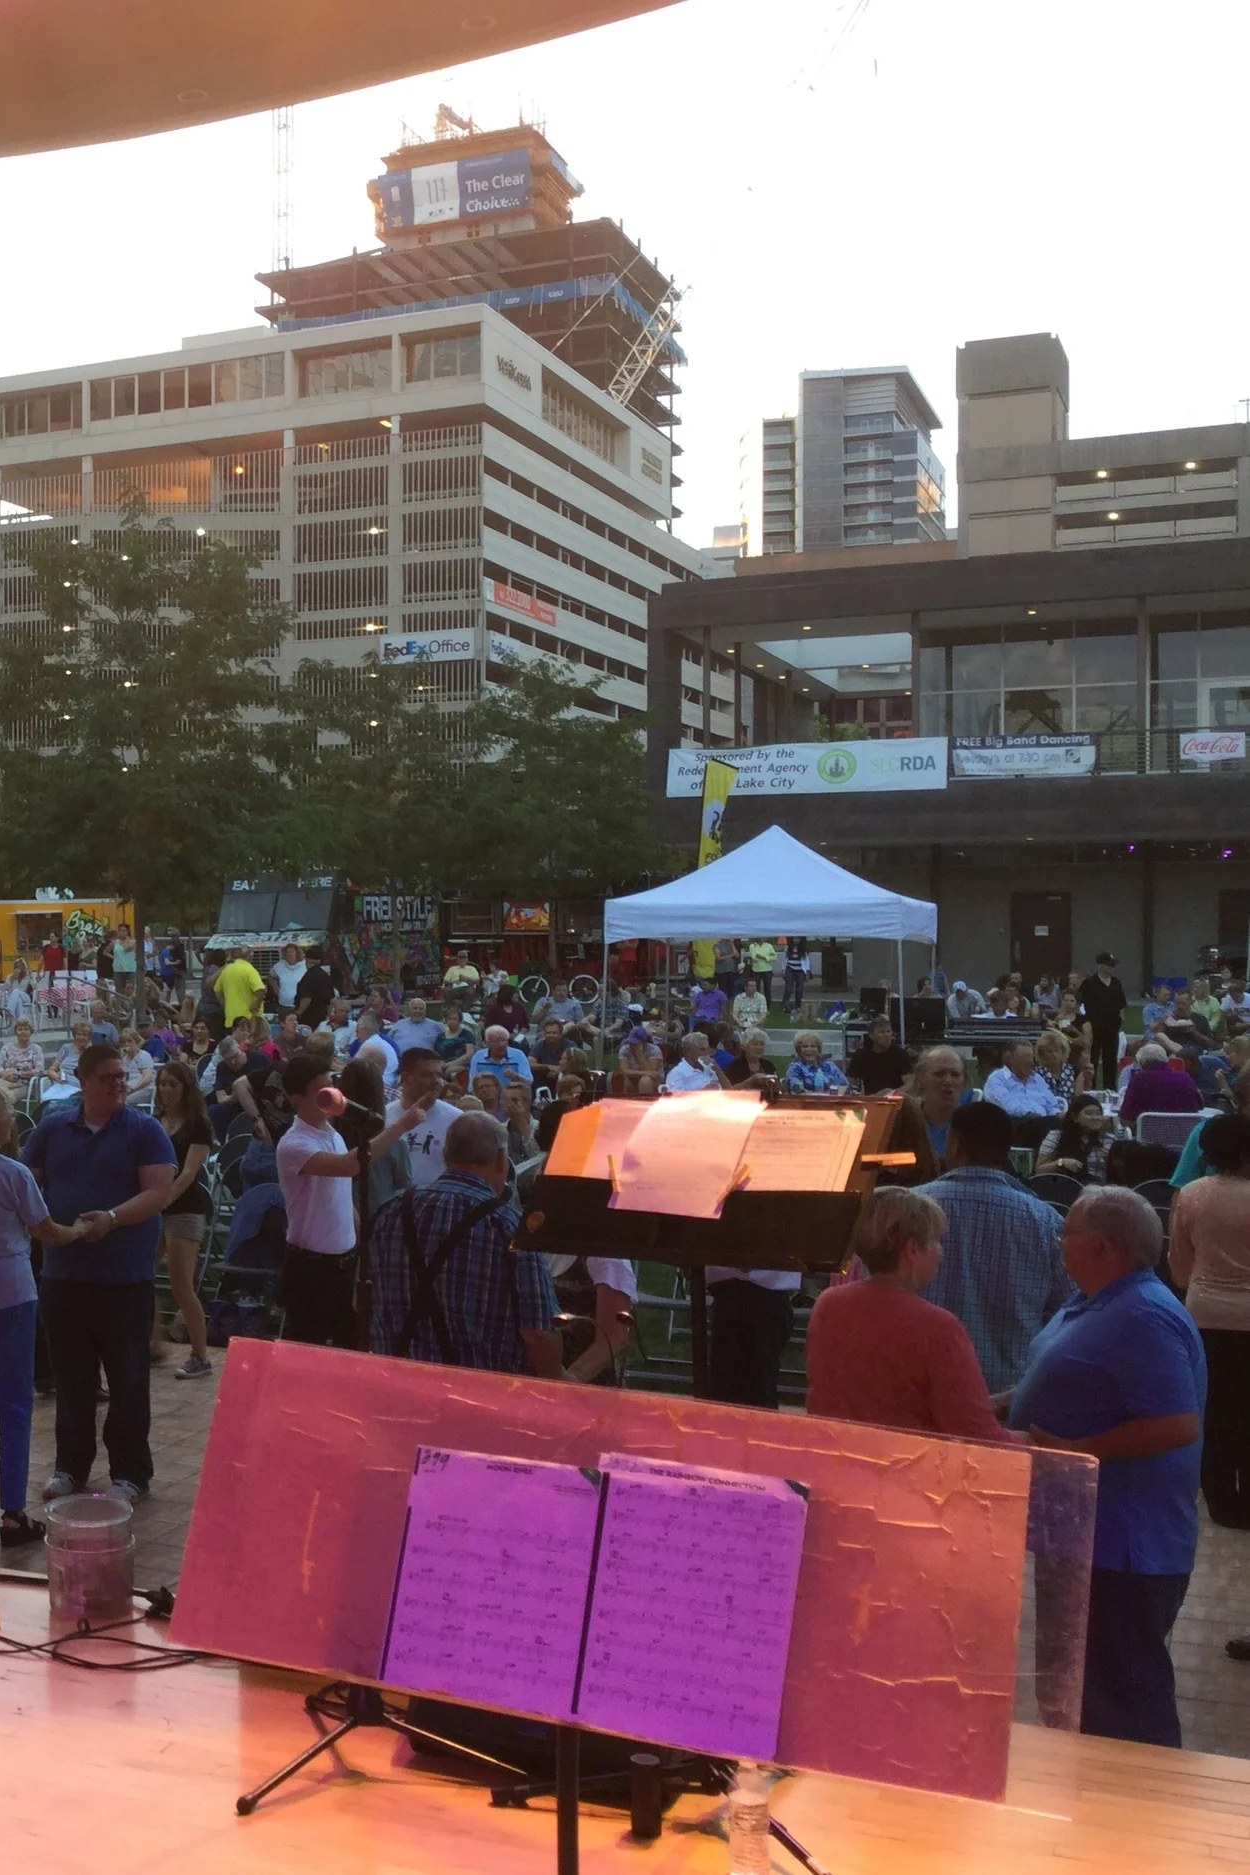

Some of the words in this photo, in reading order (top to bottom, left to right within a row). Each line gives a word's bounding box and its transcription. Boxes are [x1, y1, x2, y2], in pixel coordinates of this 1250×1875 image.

[465, 178, 489, 194] The
[491, 173, 526, 189] Clear
[383, 640, 427, 658] FedEx
[429, 639, 470, 654] Office
[956, 737, 981, 747] FREE
[985, 737, 1004, 748] Big
[1006, 735, 1037, 746] Band
[1040, 734, 1091, 746] Dancing
[695, 751, 754, 764] Sponsored
[757, 750, 771, 761] by
[776, 749, 795, 759] the
[766, 763, 809, 775] Agency
[736, 778, 765, 789] Lake
[770, 777, 796, 789] City
[649, 1467, 664, 1476] THE
[666, 1470, 706, 1482] RAINBOW
[708, 1477, 766, 1491] CONNECTION
